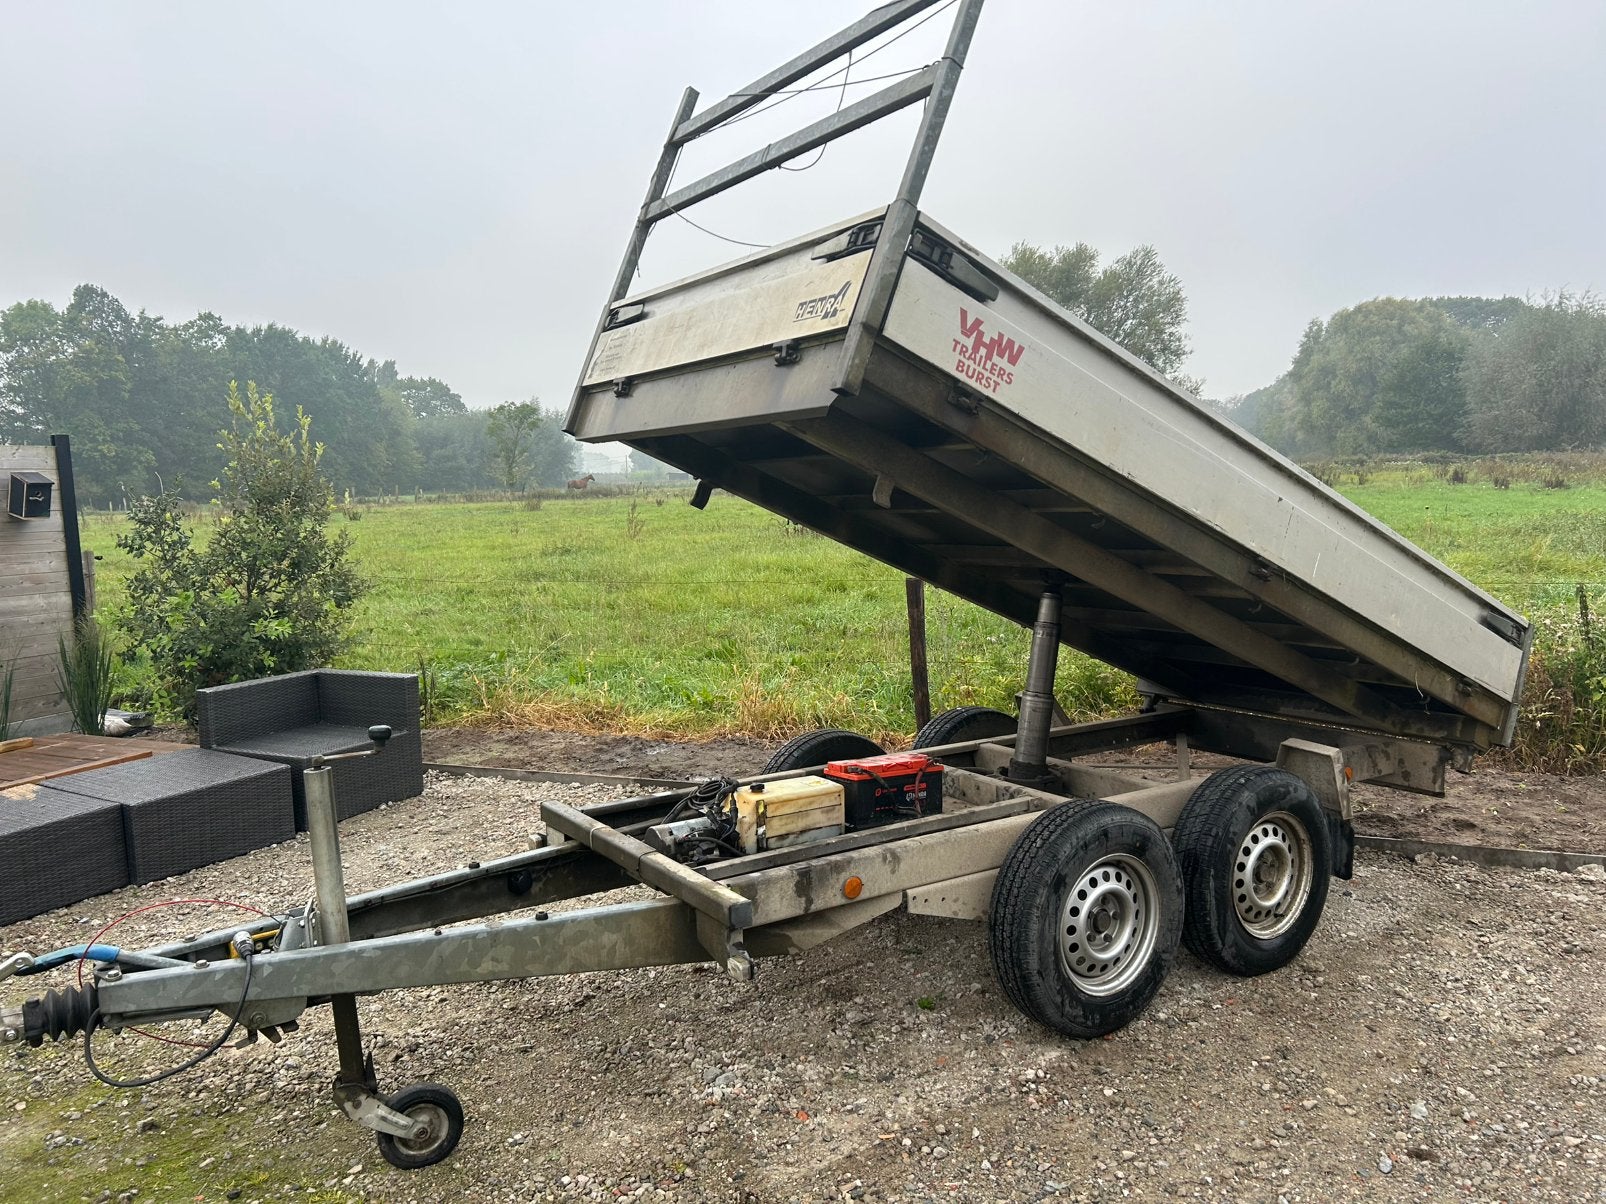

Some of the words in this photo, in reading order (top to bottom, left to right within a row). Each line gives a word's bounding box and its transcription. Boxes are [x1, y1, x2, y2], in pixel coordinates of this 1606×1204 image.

[794, 283, 850, 320] HENRA
[959, 306, 1026, 367] VHW
[951, 338, 1014, 385] TRAILERS
[955, 359, 1001, 394] BURST
